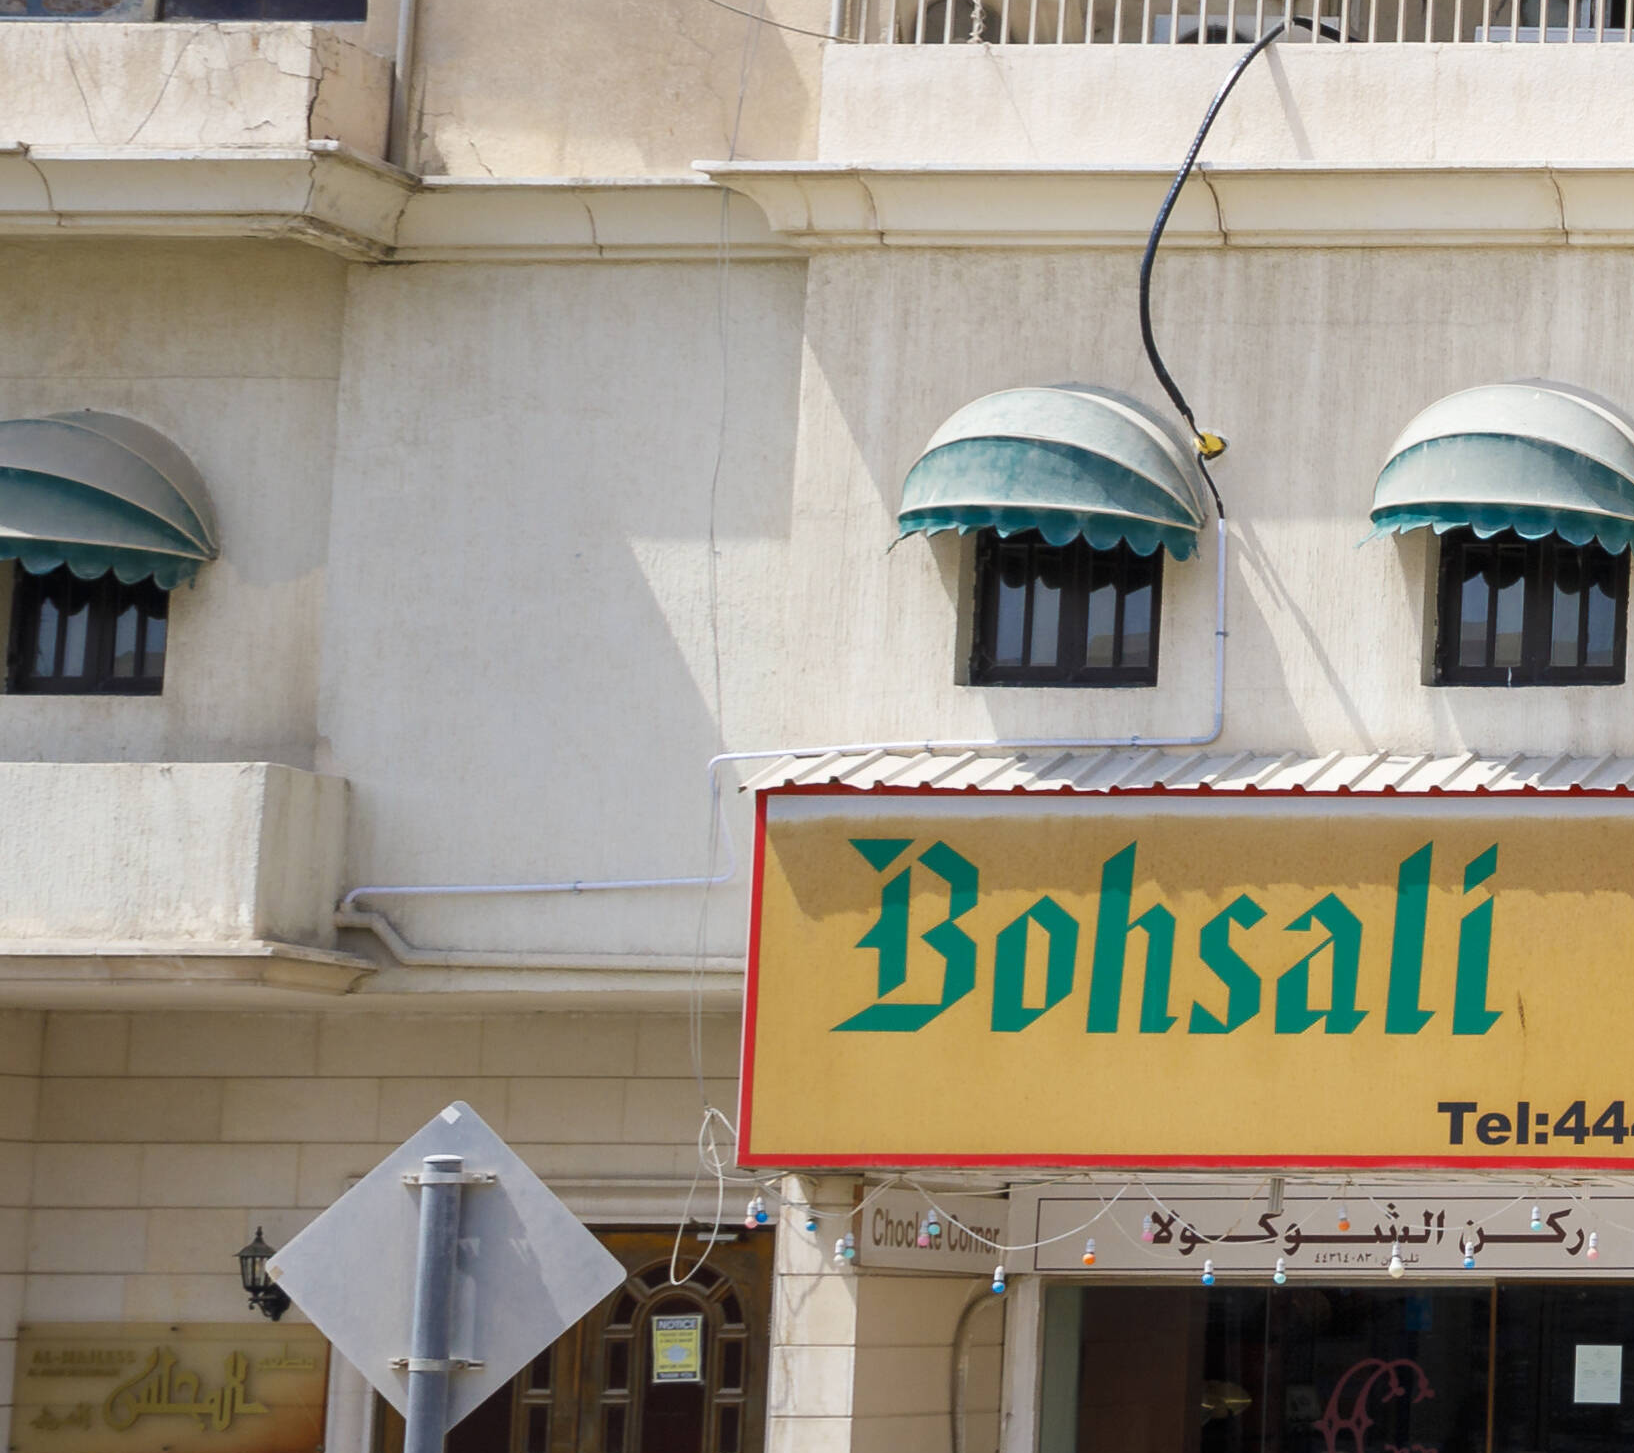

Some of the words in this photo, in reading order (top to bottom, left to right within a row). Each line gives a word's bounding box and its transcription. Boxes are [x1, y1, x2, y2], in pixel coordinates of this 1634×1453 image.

[830, 839, 1503, 1035] Bohsali
[872, 1207, 943, 1250] Chocle
[947, 1214, 1000, 1255] Corner
[1458, 1208, 1586, 1256] ركن
